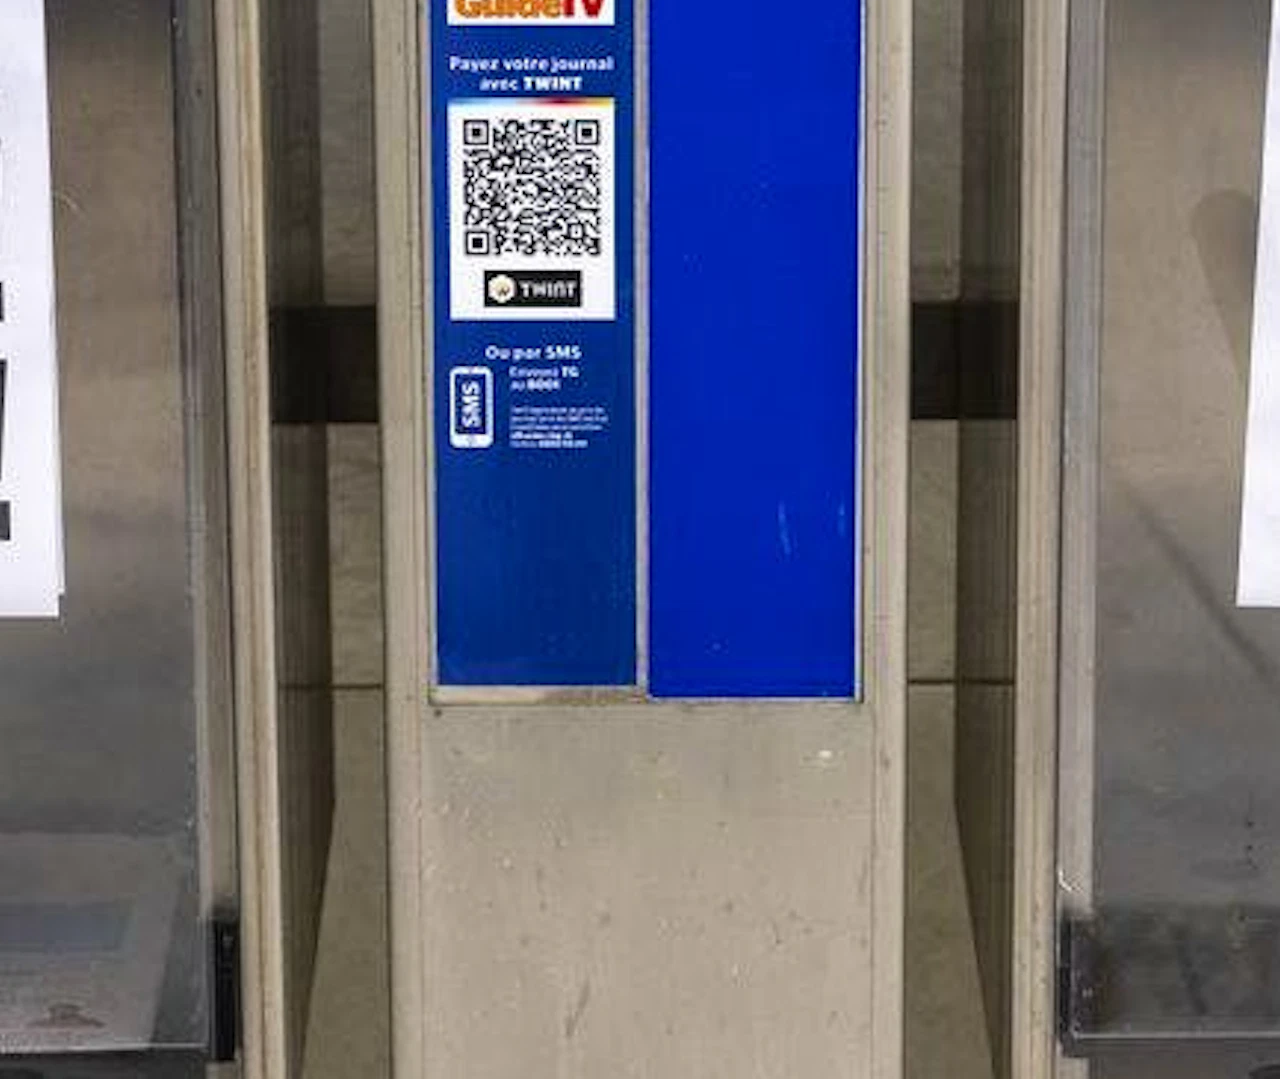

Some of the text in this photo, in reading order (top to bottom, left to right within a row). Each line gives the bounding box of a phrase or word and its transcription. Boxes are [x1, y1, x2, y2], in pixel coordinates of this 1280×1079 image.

[449, 55, 616, 73] Payez votre journal
[480, 76, 583, 91] avec TWINT
[519, 280, 577, 298] TWINT
[485, 345, 583, 362] Ou par SMS
[462, 380, 481, 429] SMS
